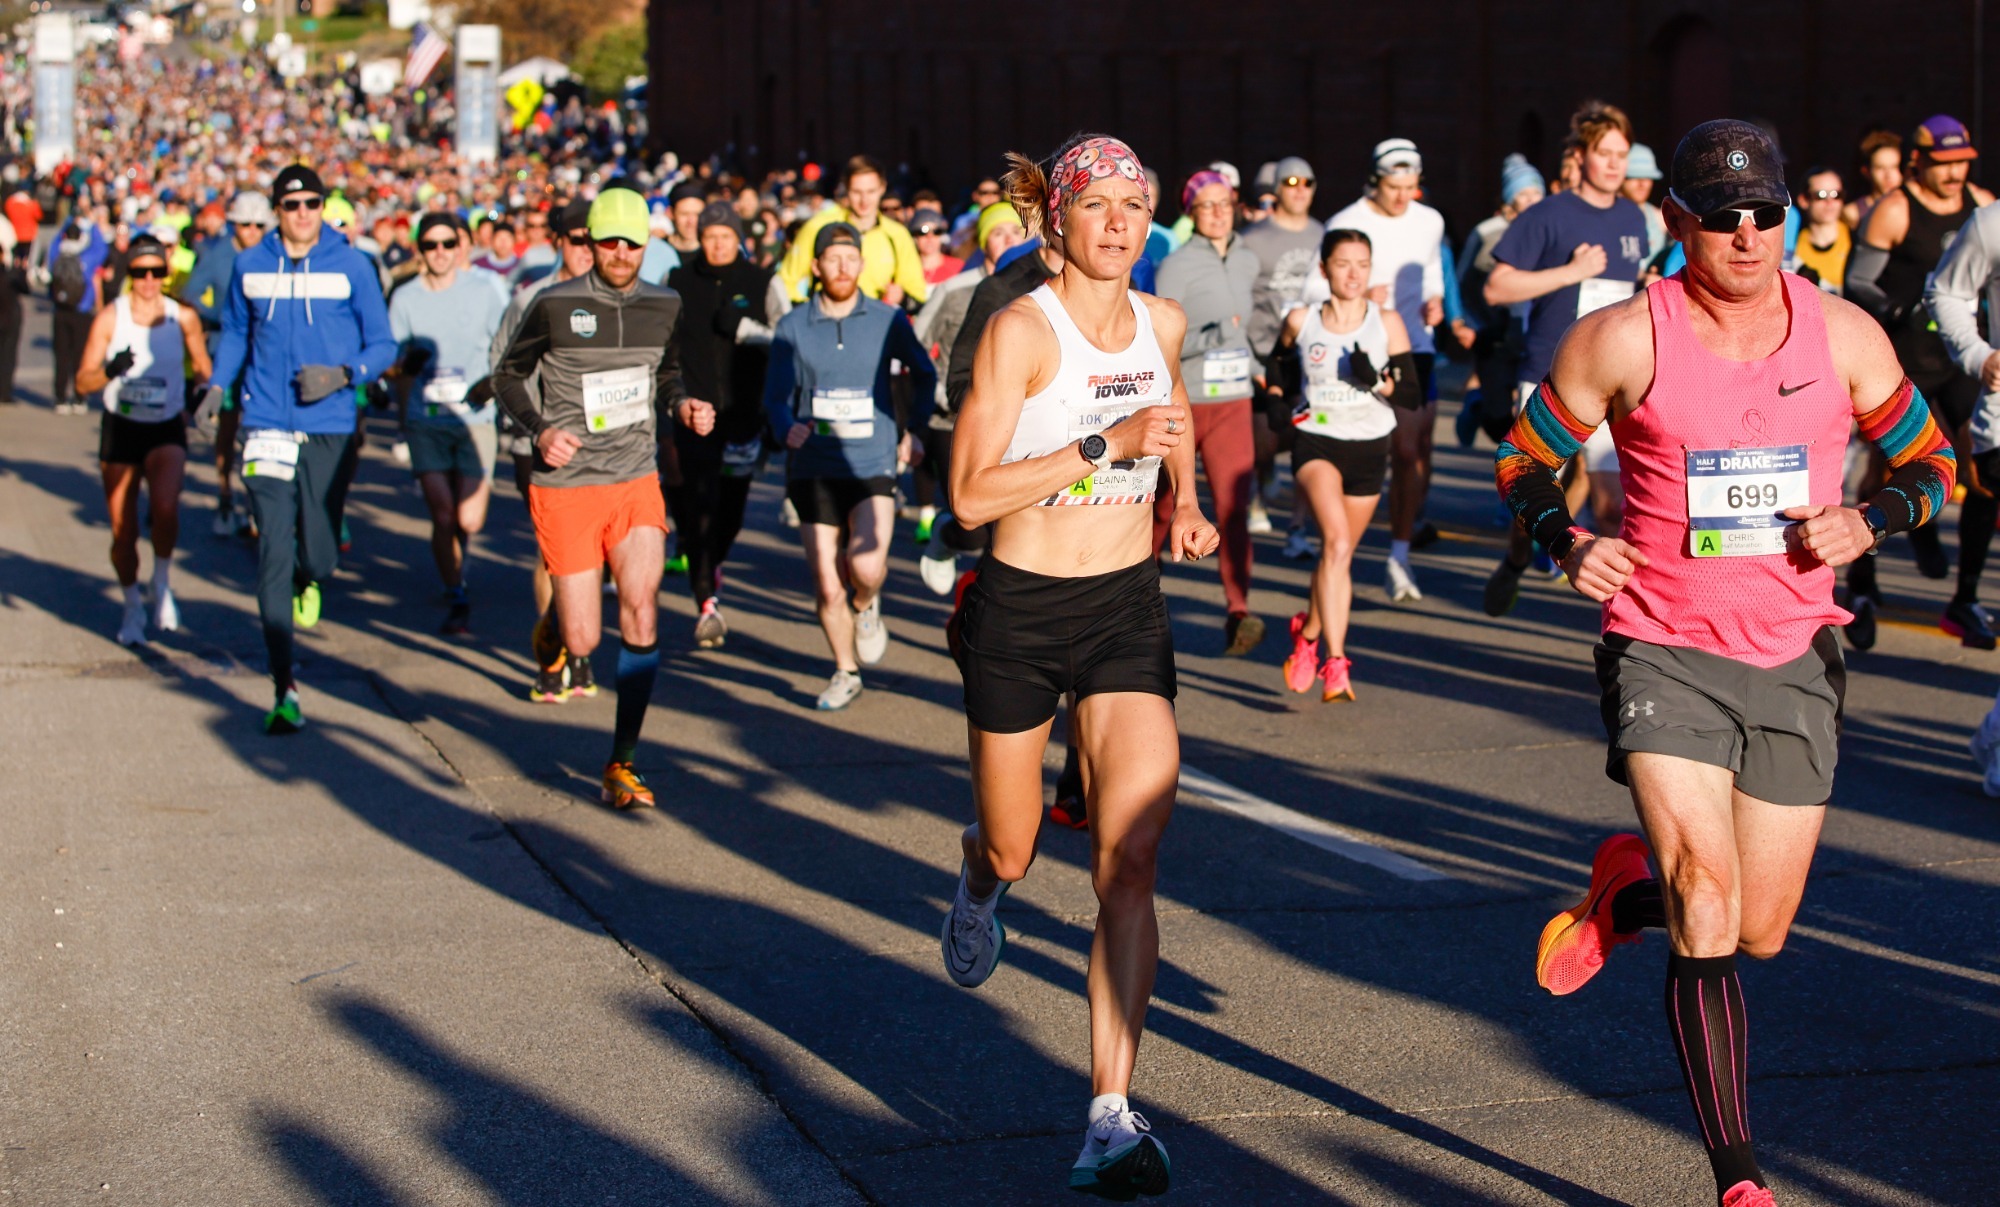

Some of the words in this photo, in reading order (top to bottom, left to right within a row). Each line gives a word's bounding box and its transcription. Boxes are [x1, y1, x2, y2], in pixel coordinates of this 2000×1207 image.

[1732, 153, 1745, 167] C
[598, 386, 639, 405] 10024
[1095, 383, 1139, 399] IOWA
[834, 404, 851, 416] 50
[1079, 413, 1102, 426] 10K
[1102, 409, 1136, 424] DRAK
[1696, 458, 1716, 466] HALF
[1720, 455, 1772, 471] DRAKE
[1073, 479, 1087, 492] A
[1093, 475, 1127, 485] ELAINA
[1727, 483, 1778, 509] 699
[1700, 536, 1715, 552] A
[1728, 533, 1755, 542] CHRIS
